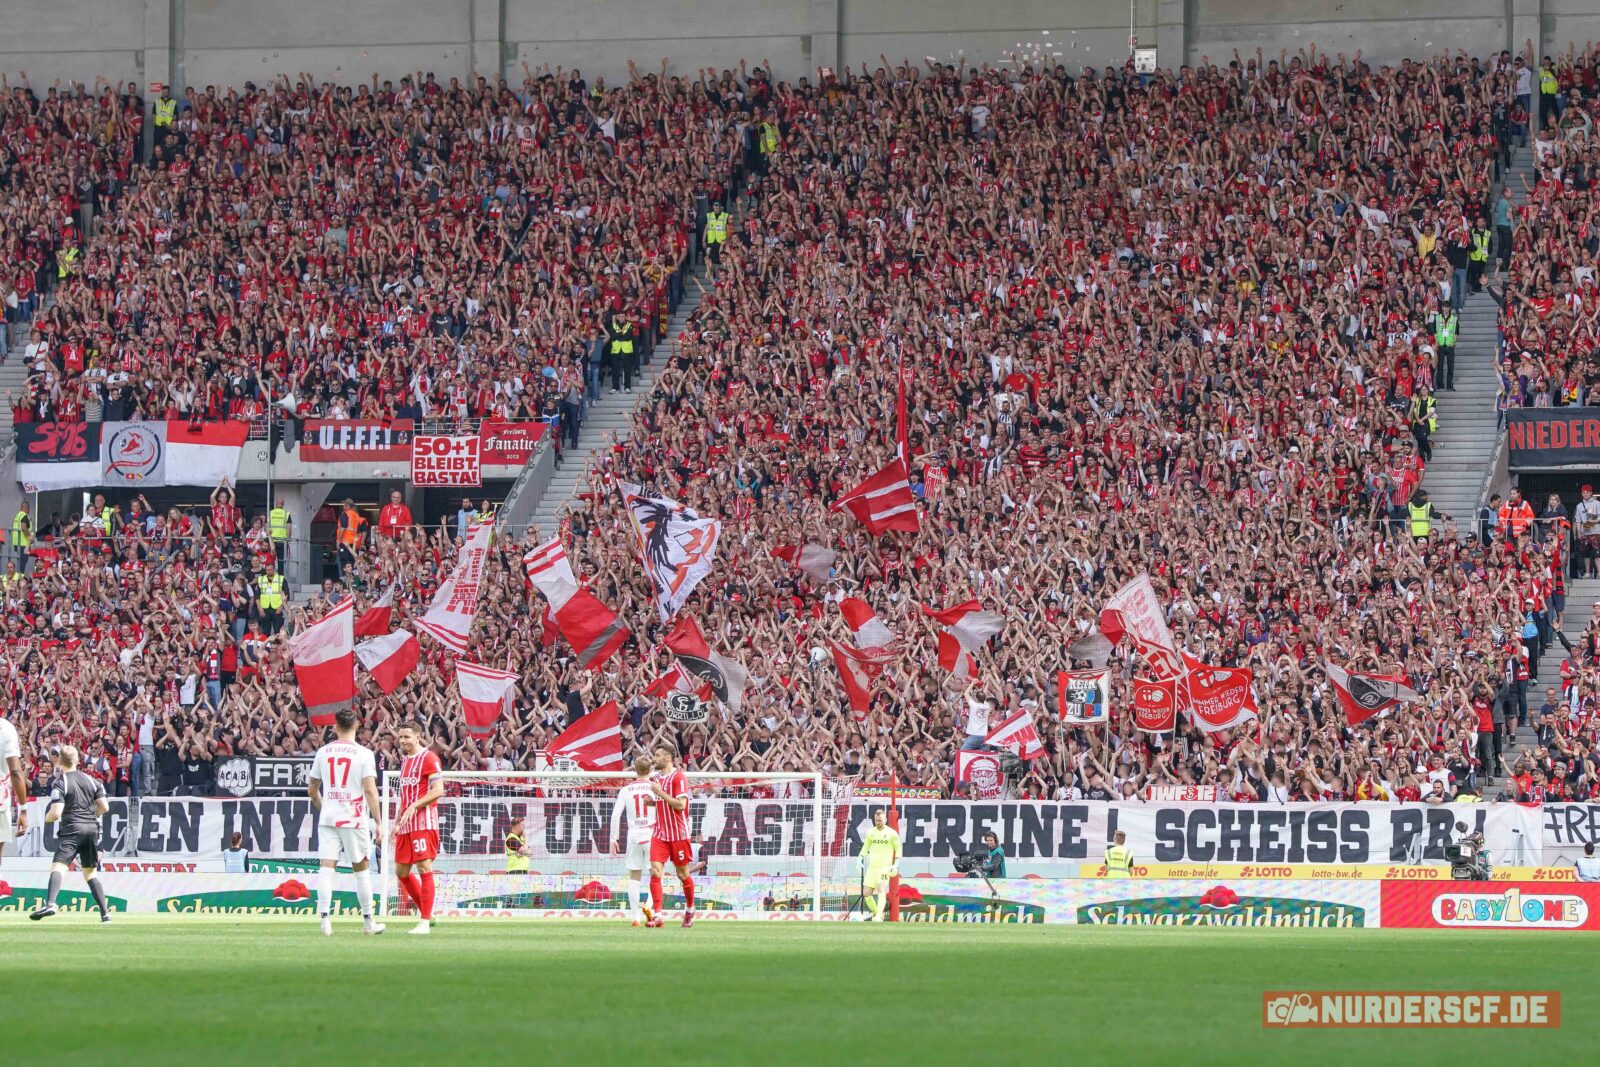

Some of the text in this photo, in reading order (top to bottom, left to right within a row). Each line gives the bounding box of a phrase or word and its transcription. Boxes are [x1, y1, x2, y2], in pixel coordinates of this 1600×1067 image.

[1508, 419, 1600, 450] NIEDER
[414, 437, 479, 456] 50+1
[414, 457, 478, 470] BLEIBT.
[414, 471, 478, 485] BASTA!
[1220, 686, 1244, 700] WIEDER
[1198, 694, 1241, 716] FREIBURG
[327, 757, 352, 788] 17
[980, 788, 1001, 798] AHRE
[44, 801, 204, 853] GEN
[543, 801, 628, 855] UN
[1155, 808, 1371, 863] SCHEISS
[412, 839, 427, 853] 30
[678, 850, 685, 861] 5
[1168, 867, 1576, 880] lotto-bw.de LOTTO lotto-bw.de LOTTO LOTT
[1087, 904, 1354, 928] Schwarzwaldmilch
